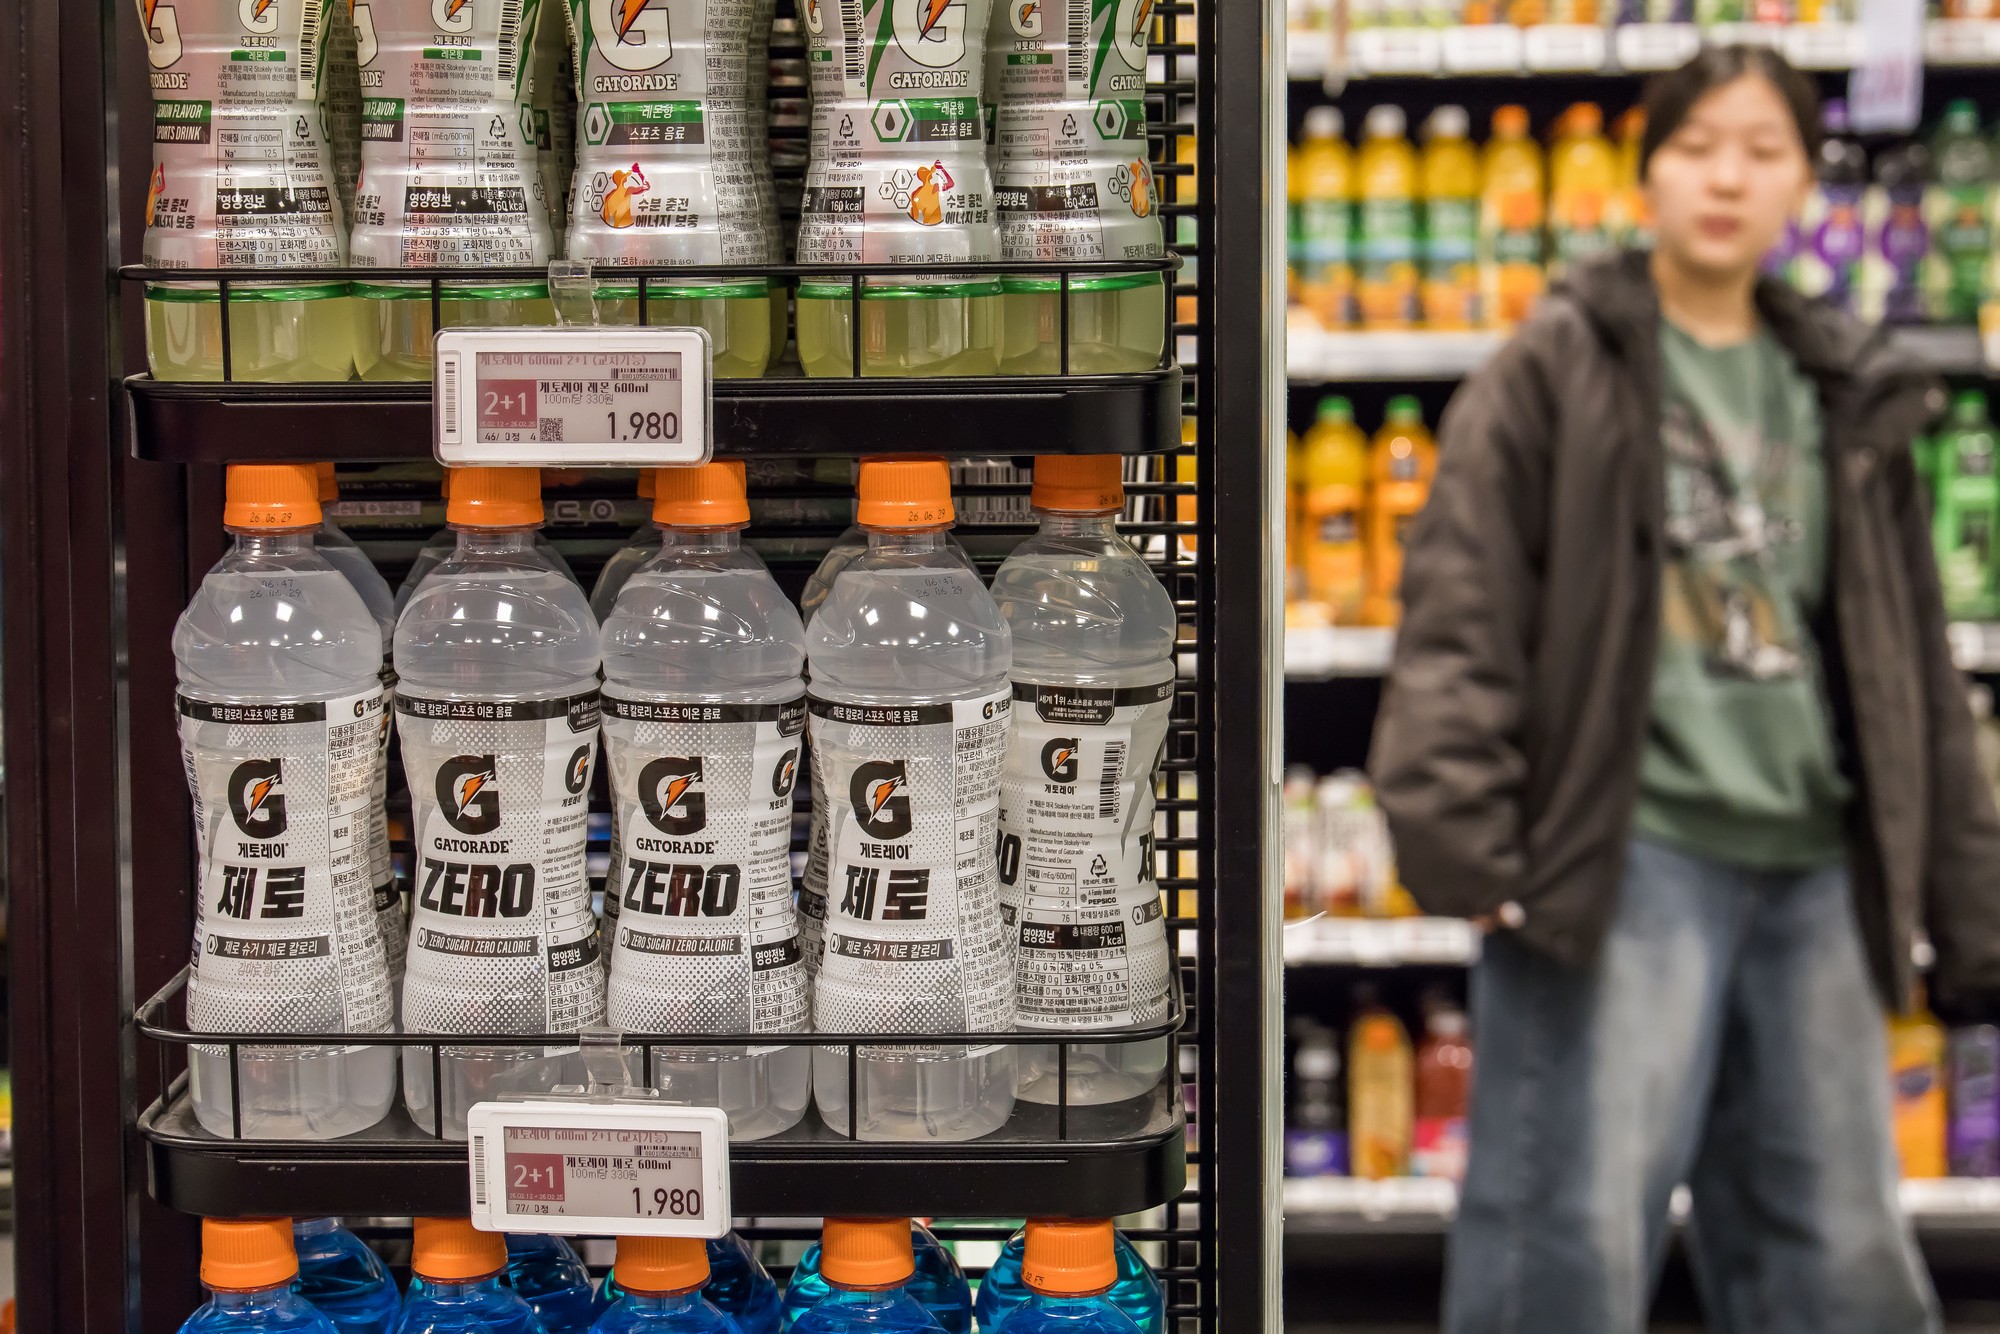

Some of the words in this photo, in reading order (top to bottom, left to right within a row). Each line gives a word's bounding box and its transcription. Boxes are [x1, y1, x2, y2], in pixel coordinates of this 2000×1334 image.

[241, 36, 277, 47] 게토레이
[434, 36, 471, 46] 게토레이
[1014, 41, 1044, 50] 게토레이
[249, 51, 270, 61] 레몬향
[442, 50, 463, 59] 레몬향
[1020, 55, 1037, 64] 레몬향
[593, 74, 678, 93] GATORADE
[889, 71, 967, 89] GATORADE
[172, 105, 202, 118] FLAVOR
[370, 102, 396, 116] FLAVOR
[642, 105, 674, 119] 레몬향
[941, 101, 964, 115] 레몬향
[176, 126, 201, 140] DRINK
[629, 127, 660, 141] 스포츠
[665, 127, 685, 140] 음료
[931, 124, 957, 136] 스포츠
[960, 123, 972, 136] 음료
[220, 196, 266, 209] 영양정보
[318, 200, 330, 210] kcal
[409, 193, 452, 207] 영양정보
[638, 199, 661, 211] 수분
[666, 198, 689, 211] 충전
[831, 201, 843, 211] 160
[845, 200, 862, 211] kcal
[947, 195, 965, 208] 수분
[969, 194, 982, 208] 충전
[635, 215, 671, 228] 에너지
[675, 215, 698, 227] 보충
[945, 211, 973, 224] 에너지
[976, 211, 988, 223] 보충
[480, 355, 523, 365] 게토레이
[529, 355, 562, 365] 600ml
[567, 355, 587, 364] 2+1
[540, 382, 582, 393] 게토레이
[588, 382, 610, 393] 레몬
[615, 383, 648, 392] 600ml
[484, 392, 526, 415] 2+1
[586, 394, 613, 405] 330원
[608, 412, 677, 441] 1,980
[909, 509, 945, 522] 26.06.29
[1054, 694, 1066, 705] 1위
[212, 709, 223, 720] 제로
[224, 709, 242, 720] 칼로리
[244, 710, 263, 720] 스포츠
[265, 710, 278, 720] 이온
[280, 710, 294, 720] 음료
[414, 703, 426, 714] 제로
[428, 704, 449, 715] 칼로리
[452, 705, 475, 716] 스포츠
[477, 706, 493, 717] 이온
[496, 706, 513, 717] 음료
[616, 704, 629, 716] 제로
[630, 704, 651, 717] 칼로리
[654, 707, 679, 719] 스포츠
[682, 708, 700, 720] 이온
[703, 708, 721, 720] 음료
[833, 707, 844, 718] 제로
[846, 708, 864, 721] 칼로리
[865, 708, 885, 722] 스포츠
[887, 710, 901, 722] 이온
[903, 711, 919, 722] 음료
[1045, 784, 1075, 795] 게토레이
[238, 843, 285, 858] 게토레이
[434, 837, 510, 854] GATORADE
[636, 837, 715, 854] GATORADE
[860, 843, 910, 859] 게토레이
[218, 865, 305, 920] 제로
[420, 857, 535, 918] ZERO
[624, 858, 741, 917] ZERO
[841, 865, 930, 920] 제로
[1088, 897, 1116, 905] PEPSICO
[1023, 928, 1055, 943] 영양정보
[1072, 927, 1078, 936] 총
[1080, 926, 1099, 936] 내용량
[1101, 925, 1113, 934] 600
[1115, 924, 1122, 932] ml
[429, 934, 444, 948] ZERO
[447, 937, 469, 952] SUGAR
[475, 939, 495, 953] ZERO
[497, 940, 531, 953] CALORIE
[631, 934, 646, 948] ZERO
[647, 936, 670, 951] SUGAR
[676, 939, 696, 952] ZERO
[699, 939, 734, 952] CALORIE
[1100, 937, 1104, 945] 7
[1107, 935, 1123, 945] kcal
[224, 941, 240, 954] 제로
[242, 942, 259, 957] 슈거
[267, 942, 288, 955] 제로
[290, 941, 318, 955] 칼로리
[845, 940, 862, 954] 제로
[863, 941, 879, 957] 슈거
[888, 943, 909, 957] 제로
[911, 942, 940, 957] 칼로리
[552, 948, 581, 967] 영양정보
[755, 949, 786, 965] 영양정보
[509, 1129, 549, 1140] 게토레이
[555, 1131, 587, 1140] 600ml
[592, 1132, 611, 1142] 2+1
[567, 1157, 607, 1168] 게토레이
[613, 1158, 634, 1169] 제로
[639, 1160, 671, 1170] 600ml
[514, 1165, 554, 1188] 2+1
[611, 1170, 637, 1180] 330원
[633, 1188, 700, 1216] 1,980
